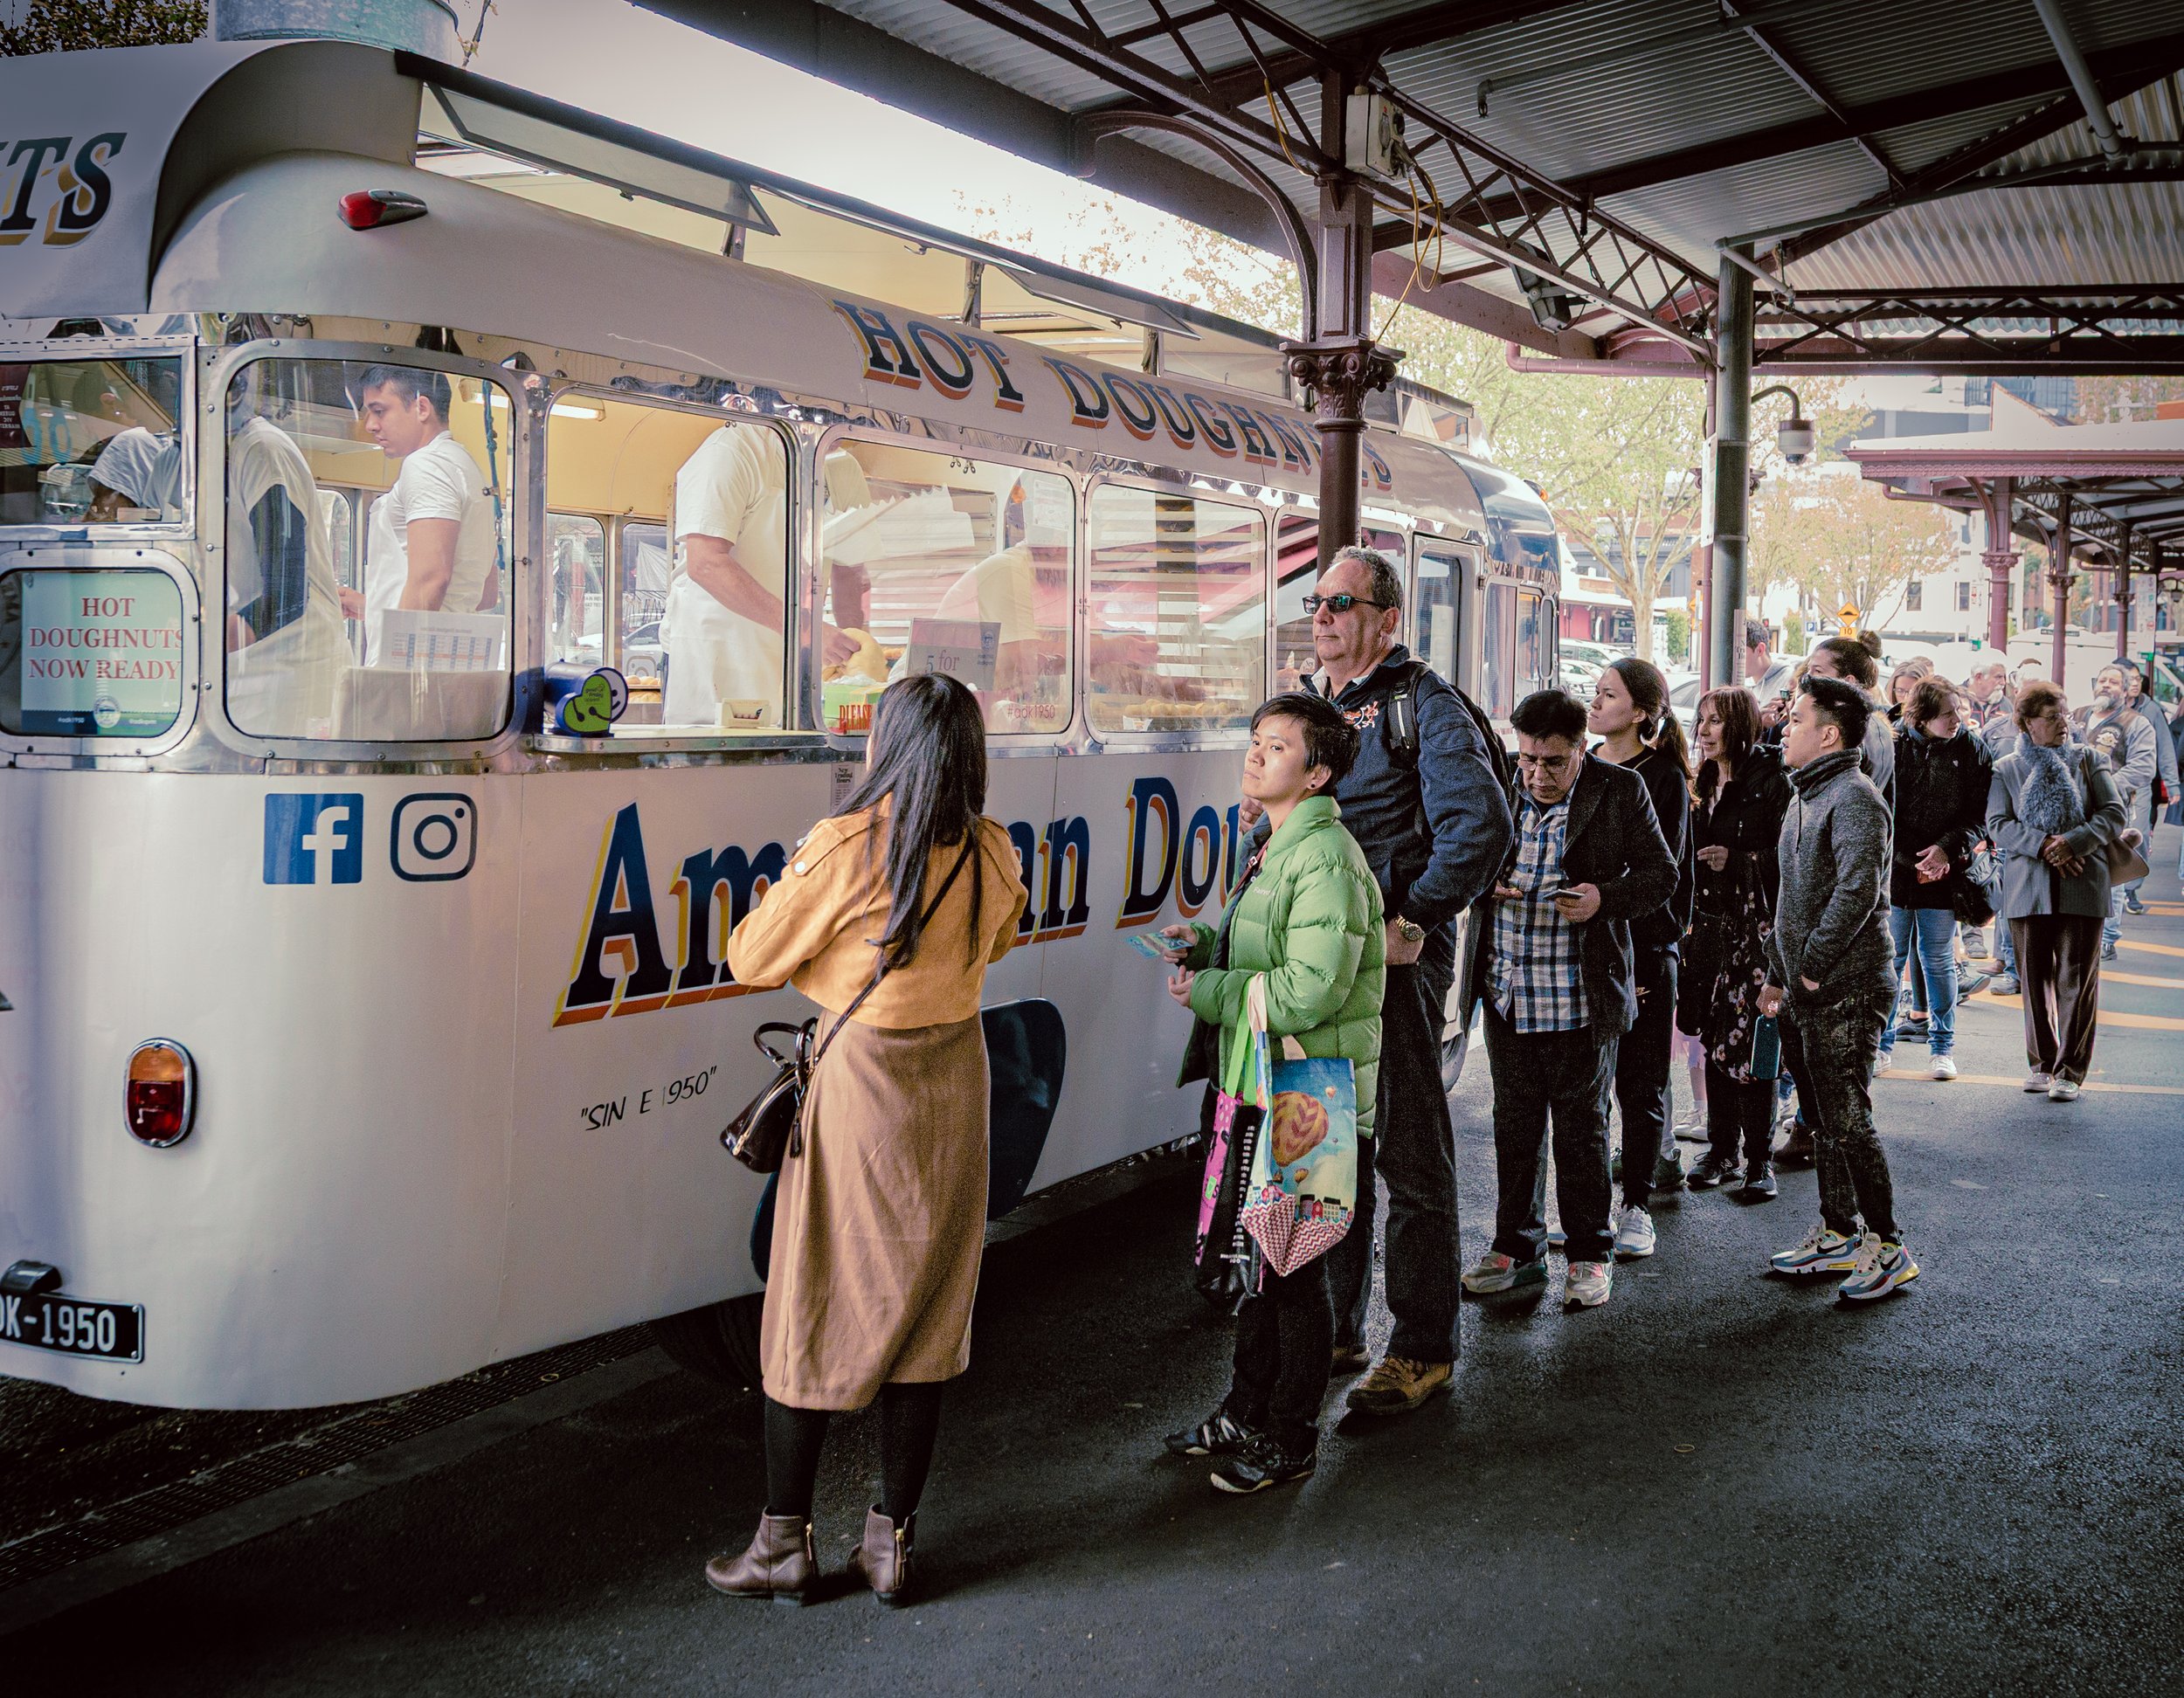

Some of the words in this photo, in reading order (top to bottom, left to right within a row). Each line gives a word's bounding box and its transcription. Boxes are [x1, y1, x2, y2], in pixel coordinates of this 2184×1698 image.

[0, 132, 128, 248] TS
[832, 299, 1026, 413] HOT
[1040, 355, 1393, 492] DOUGHNS
[80, 597, 135, 617] HOT
[29, 628, 183, 649] DOUGHNUTS
[1843, 627, 1852, 636] 10
[28, 659, 90, 680] NOW
[95, 659, 182, 680] READY
[937, 649, 960, 672] for
[1007, 704, 1055, 719] #adk1950
[550, 798, 1090, 1030] Aman
